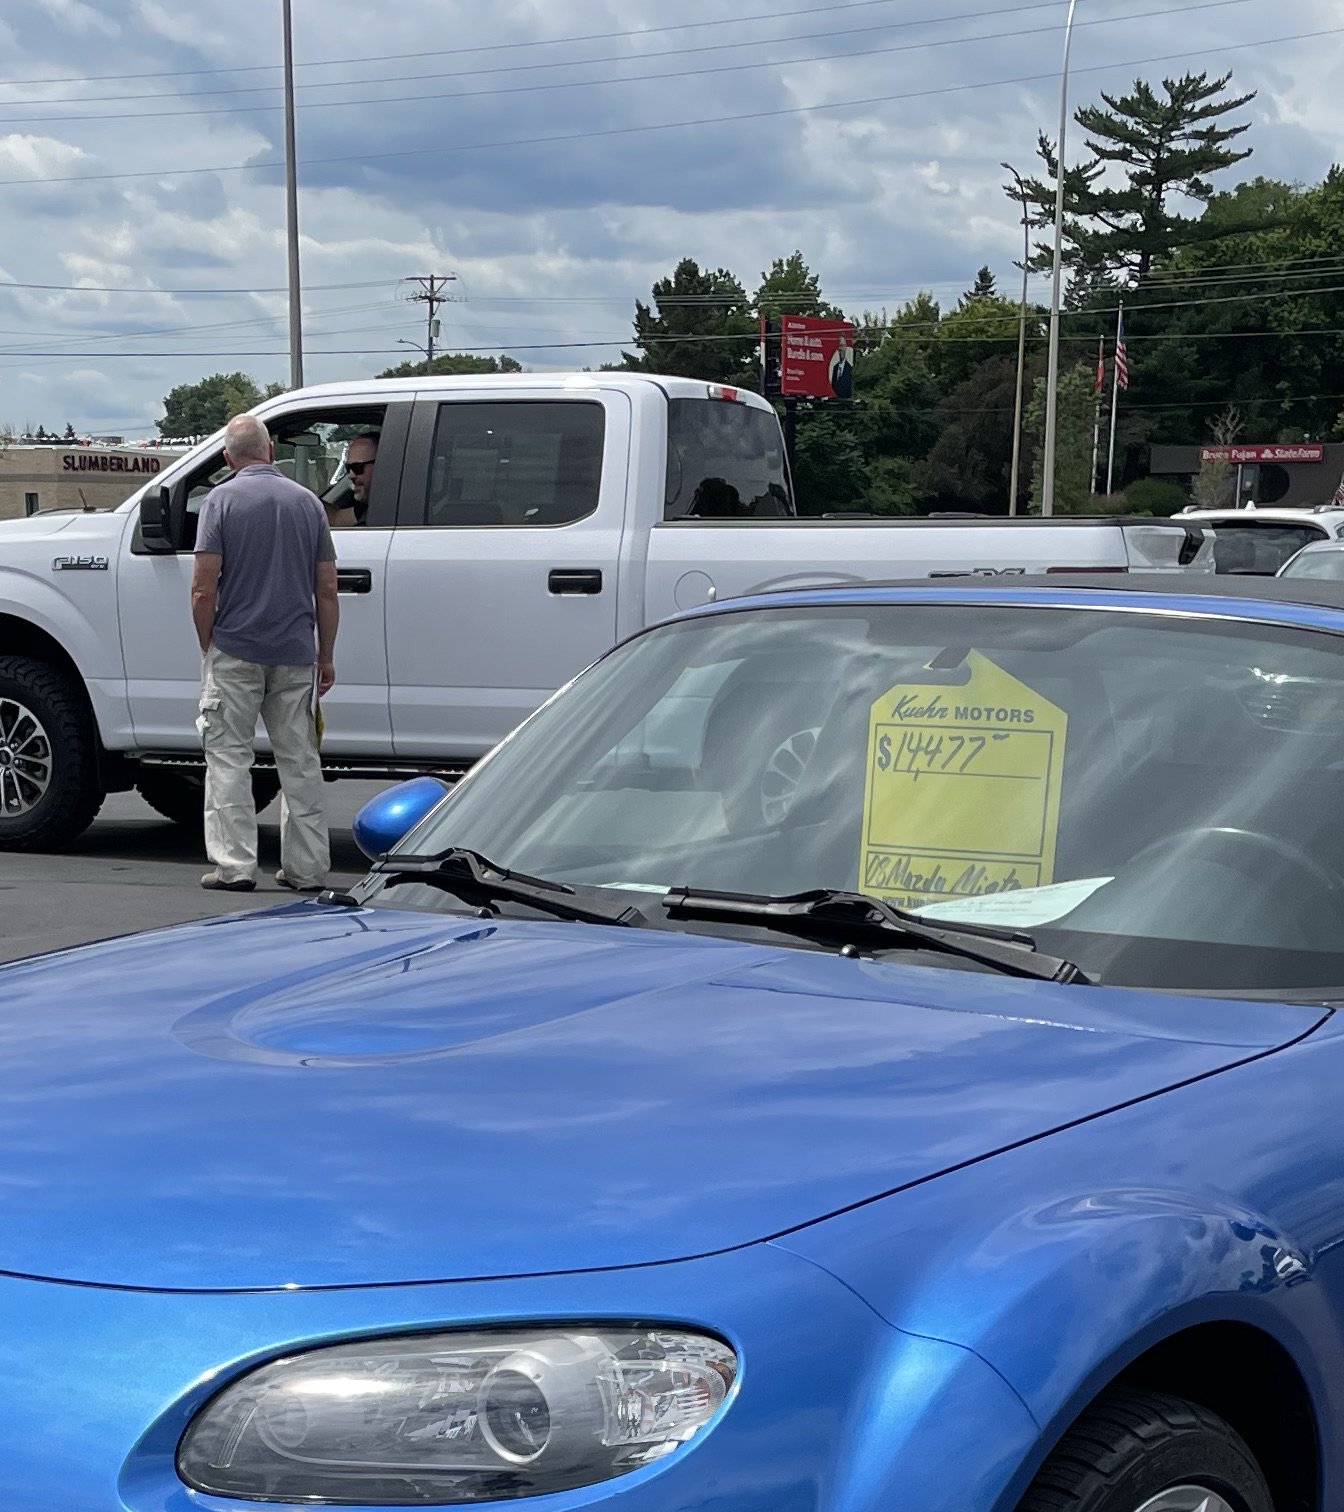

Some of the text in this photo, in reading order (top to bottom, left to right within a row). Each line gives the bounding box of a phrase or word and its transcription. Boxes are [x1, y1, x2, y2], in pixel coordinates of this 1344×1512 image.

[62, 455, 161, 474] SLUMBERLAND
[891, 694, 1035, 723] Kuehn MOTORS
